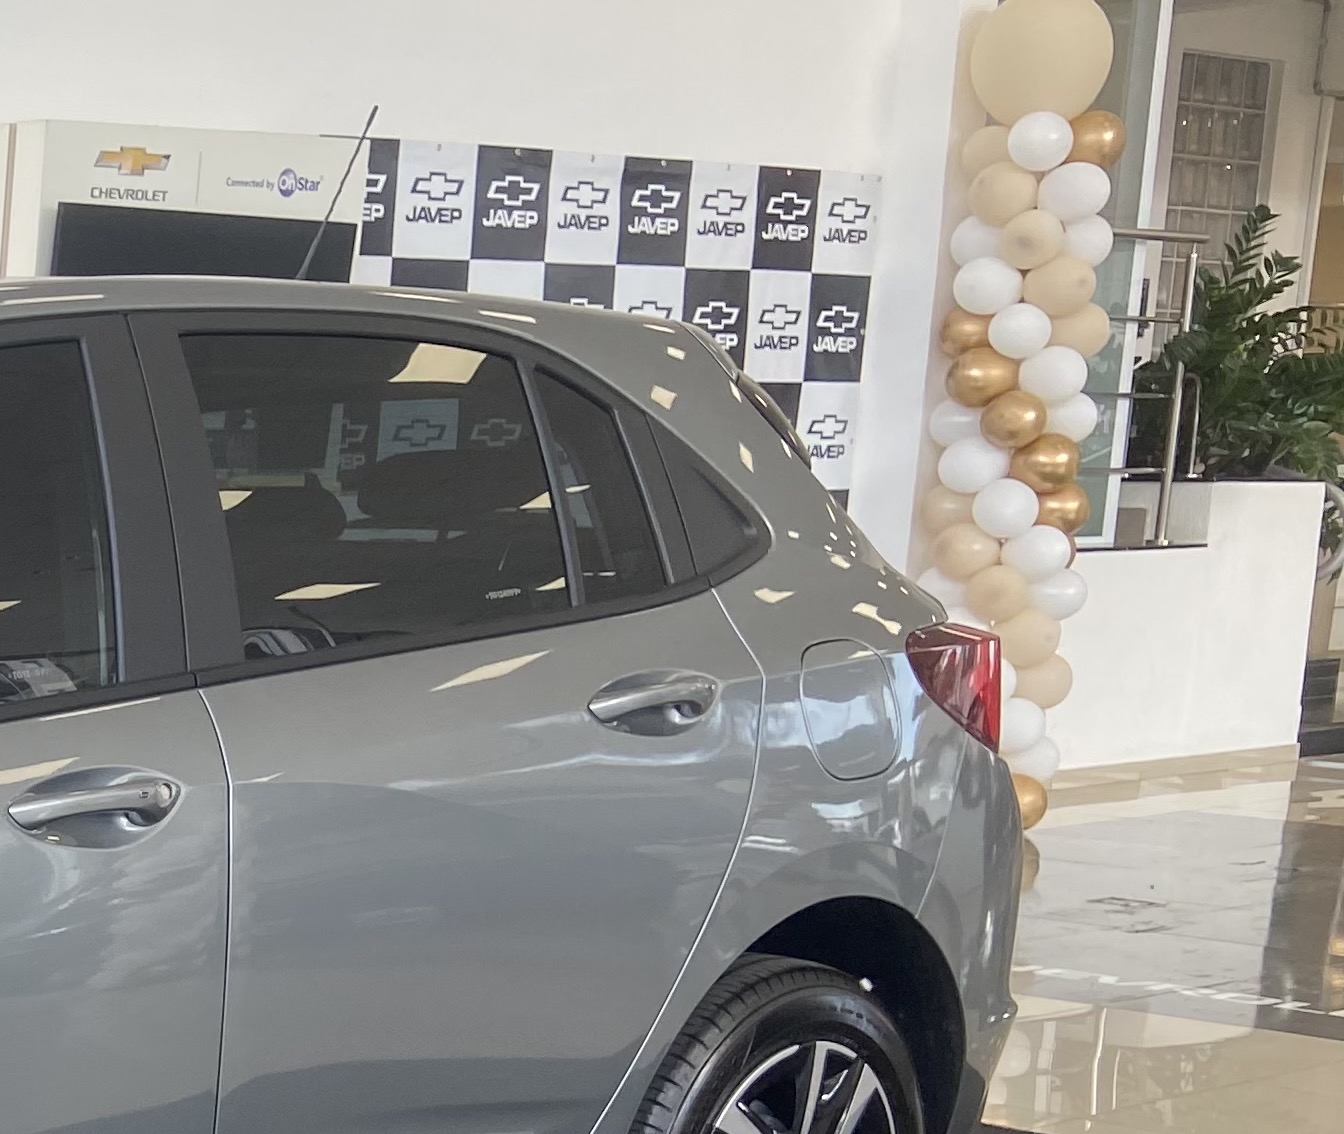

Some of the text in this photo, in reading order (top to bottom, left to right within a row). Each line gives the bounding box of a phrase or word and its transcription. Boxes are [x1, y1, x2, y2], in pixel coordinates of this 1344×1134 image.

[90, 186, 169, 203] CHEVROLET
[265, 179, 275, 192] by
[405, 205, 463, 224] JAVEP
[481, 208, 539, 229] JAVEP
[557, 213, 610, 231] JAVEP
[626, 215, 680, 236] JAVEP
[696, 219, 746, 238] JAVEP
[761, 222, 809, 242] JAVEP
[822, 227, 869, 244] JAVEP
[753, 334, 800, 351] JAVEP
[812, 334, 858, 354] JAVEP
